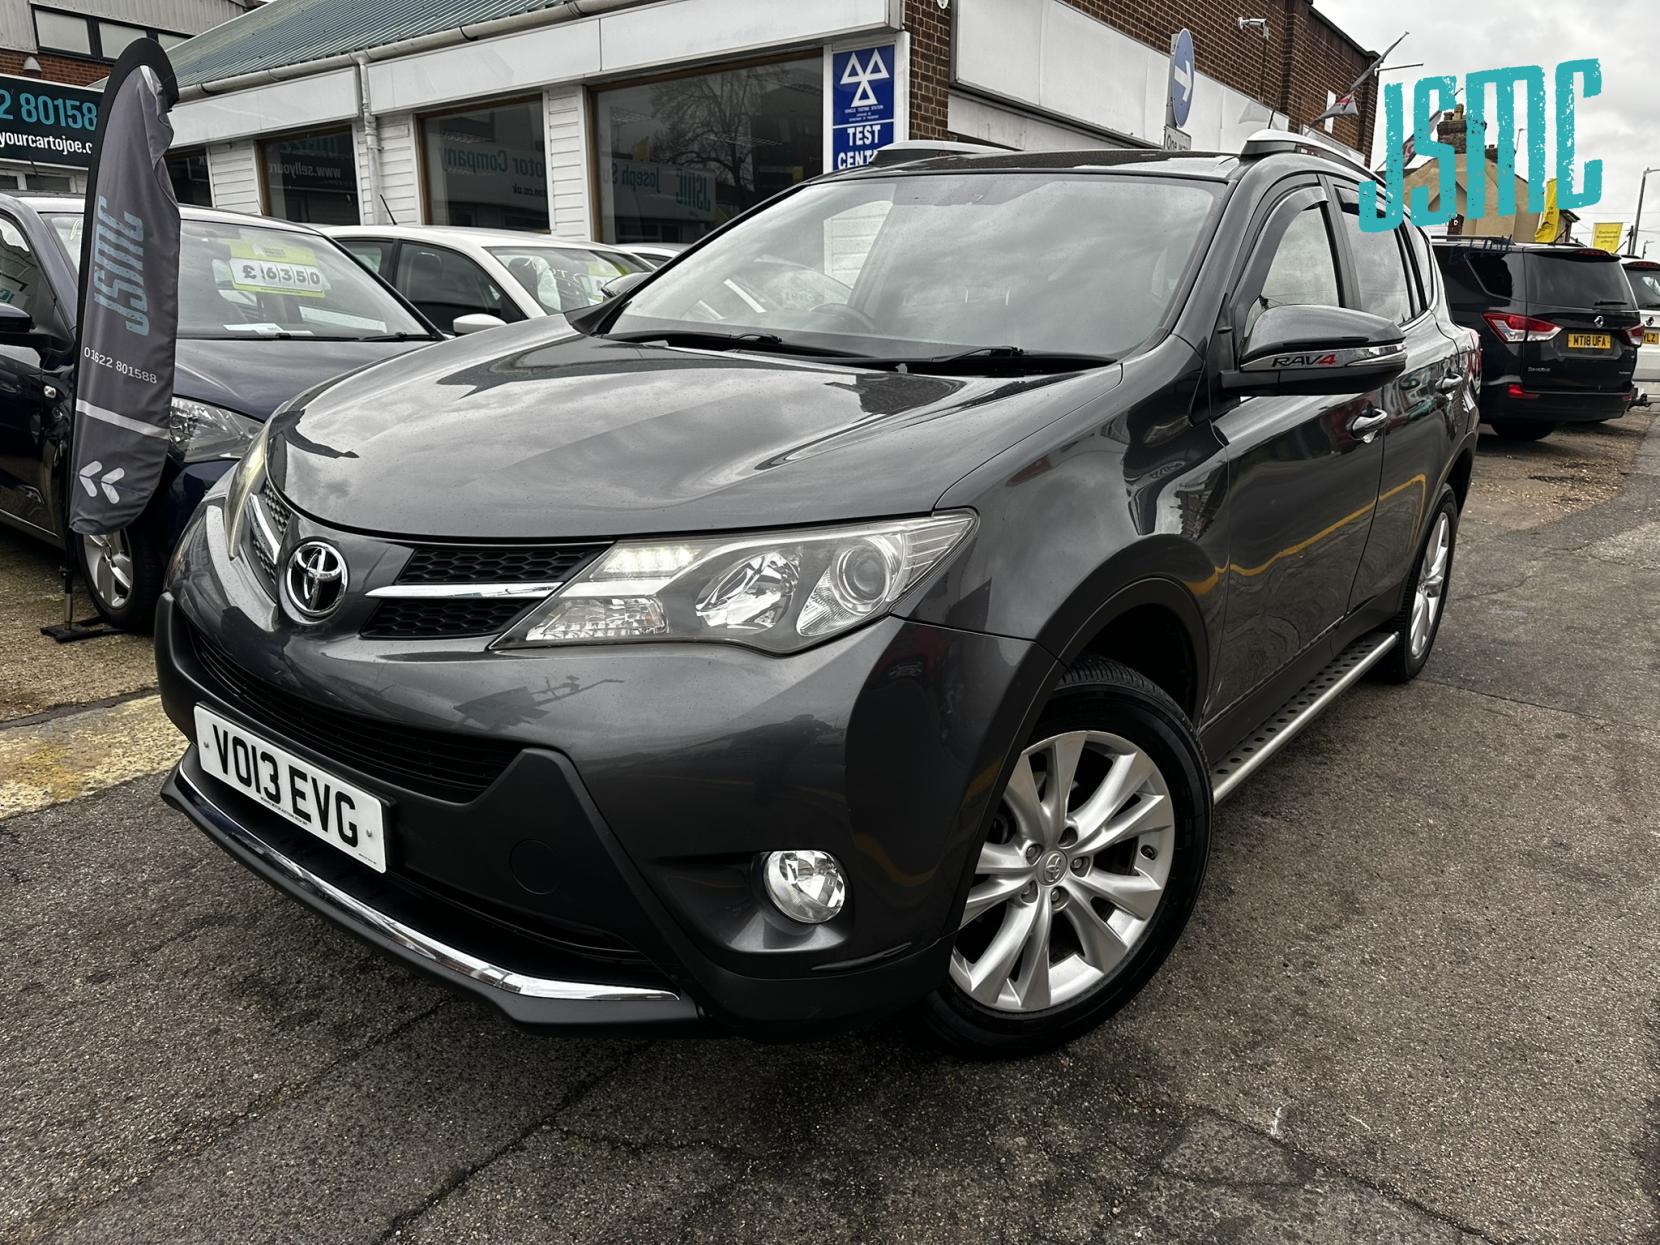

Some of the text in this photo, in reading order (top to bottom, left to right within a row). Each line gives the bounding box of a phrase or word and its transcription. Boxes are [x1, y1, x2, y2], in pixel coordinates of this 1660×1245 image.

[847, 124, 881, 146] TEST
[84, 346, 158, 384] 01622 801588
[1271, 353, 1337, 368] RAV4
[212, 724, 359, 848] VO13 EVG
